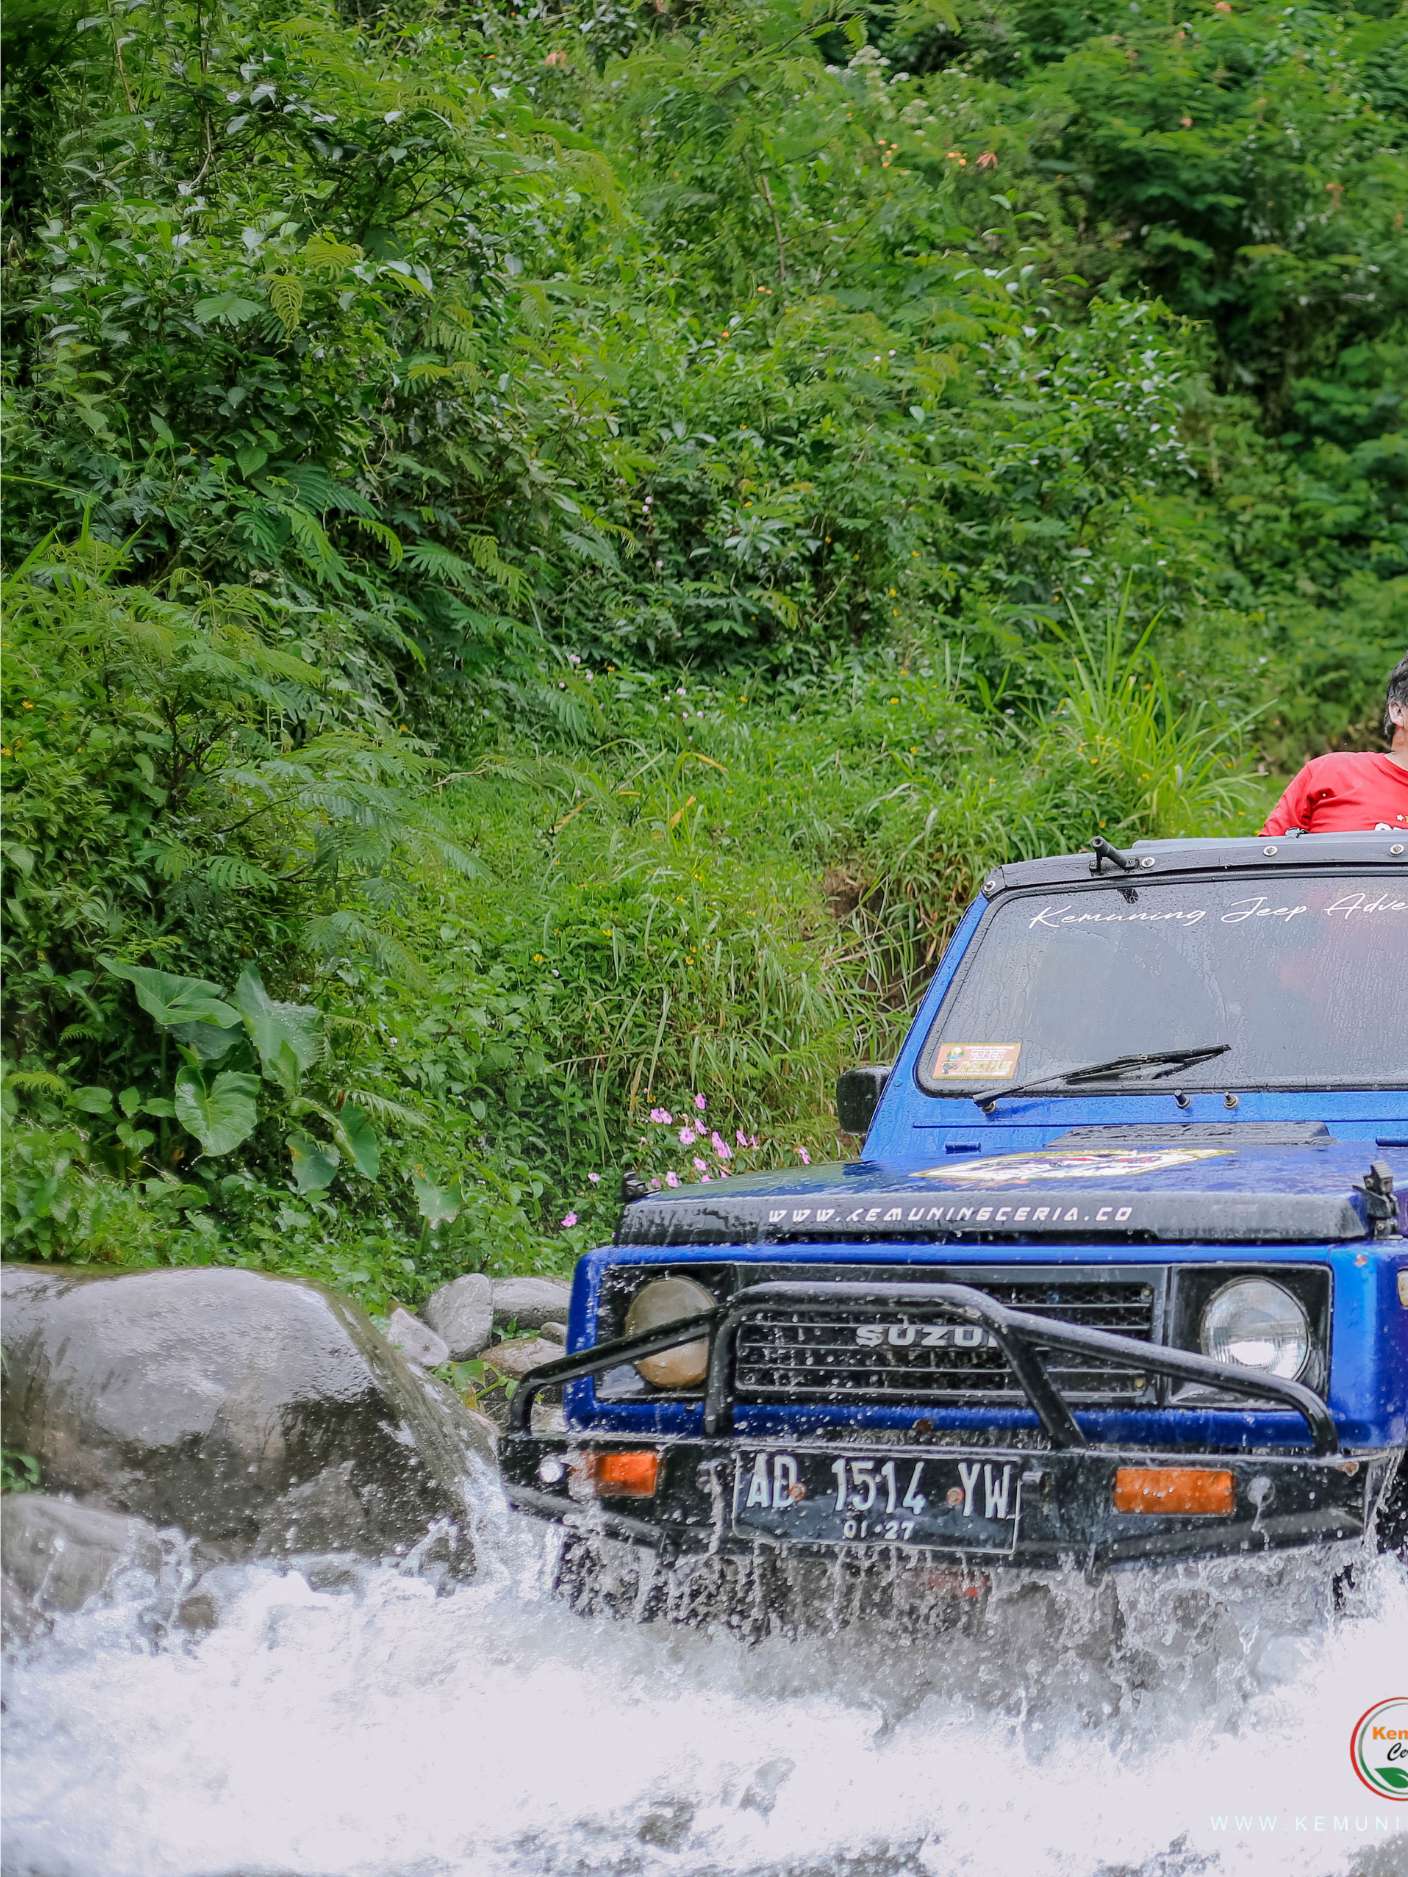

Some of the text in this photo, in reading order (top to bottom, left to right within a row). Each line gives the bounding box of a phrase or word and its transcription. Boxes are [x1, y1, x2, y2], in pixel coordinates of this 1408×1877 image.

[1028, 905, 1208, 929] Kemuning
[1220, 896, 1308, 923] Jeep
[855, 1324, 999, 1348] SUZU
[746, 1452, 1012, 1520] AD 1514 YW
